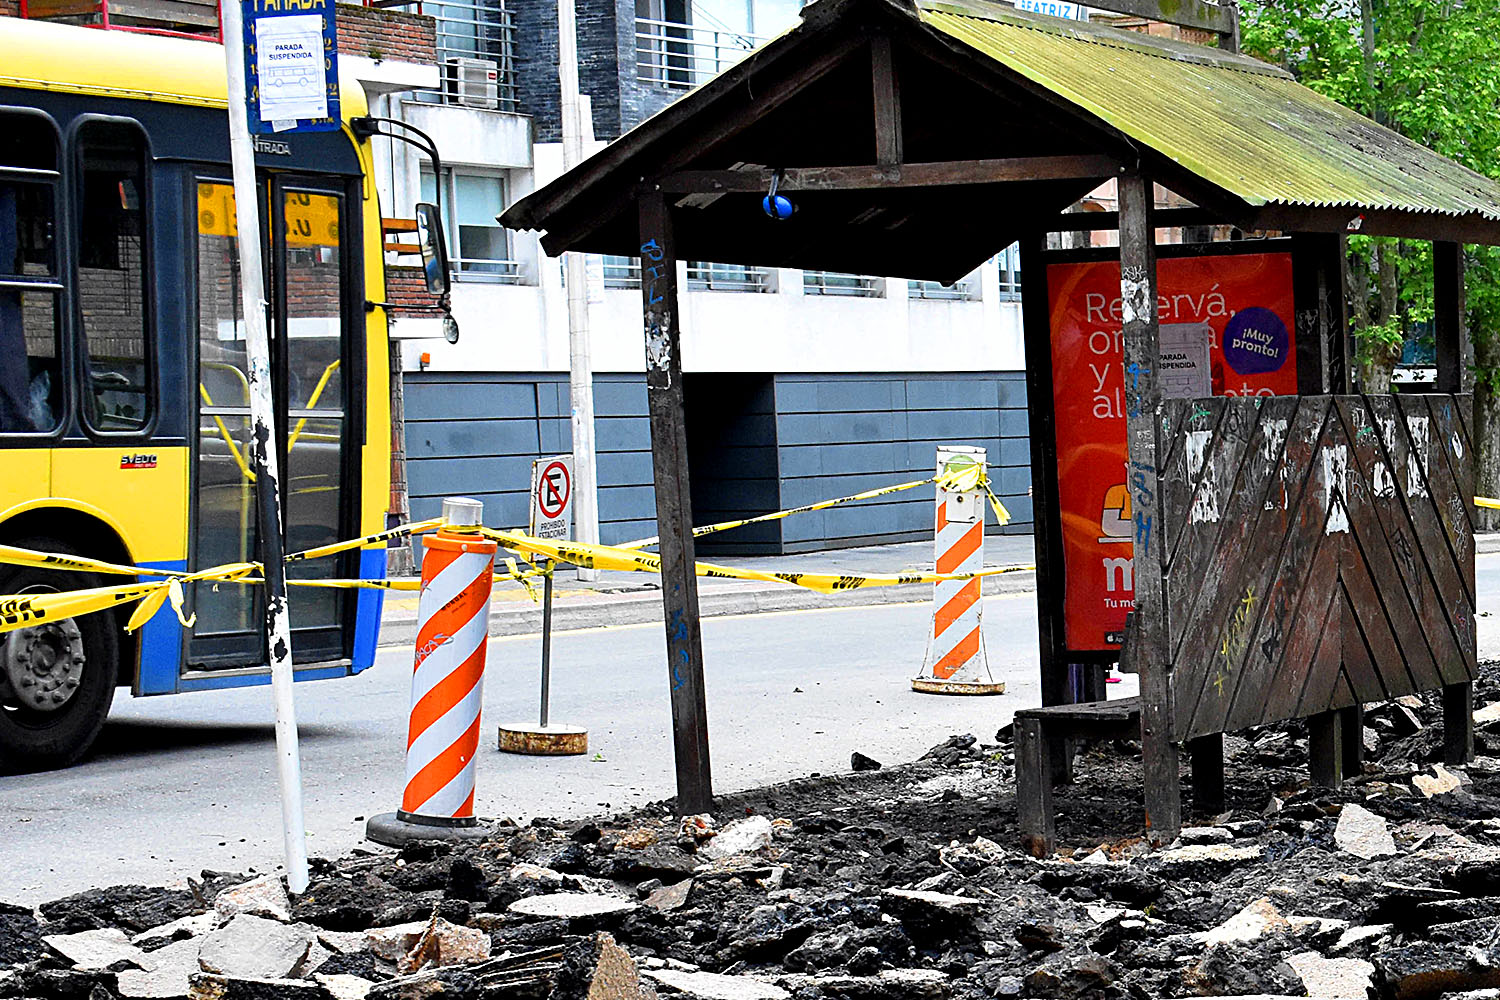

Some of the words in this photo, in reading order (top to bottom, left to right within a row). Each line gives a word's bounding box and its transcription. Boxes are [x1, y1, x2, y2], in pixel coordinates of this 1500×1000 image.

[269, 52, 313, 61] SUSPENDIDA
[1086, 283, 1236, 323] Reervá,
[1242, 328, 1274, 345] ¡Muy
[1232, 338, 1279, 358] pronto!
[540, 519, 566, 531] PROHIBIDO
[539, 527, 567, 539] ESTACIONAR
[1104, 598, 1118, 608] Tu
